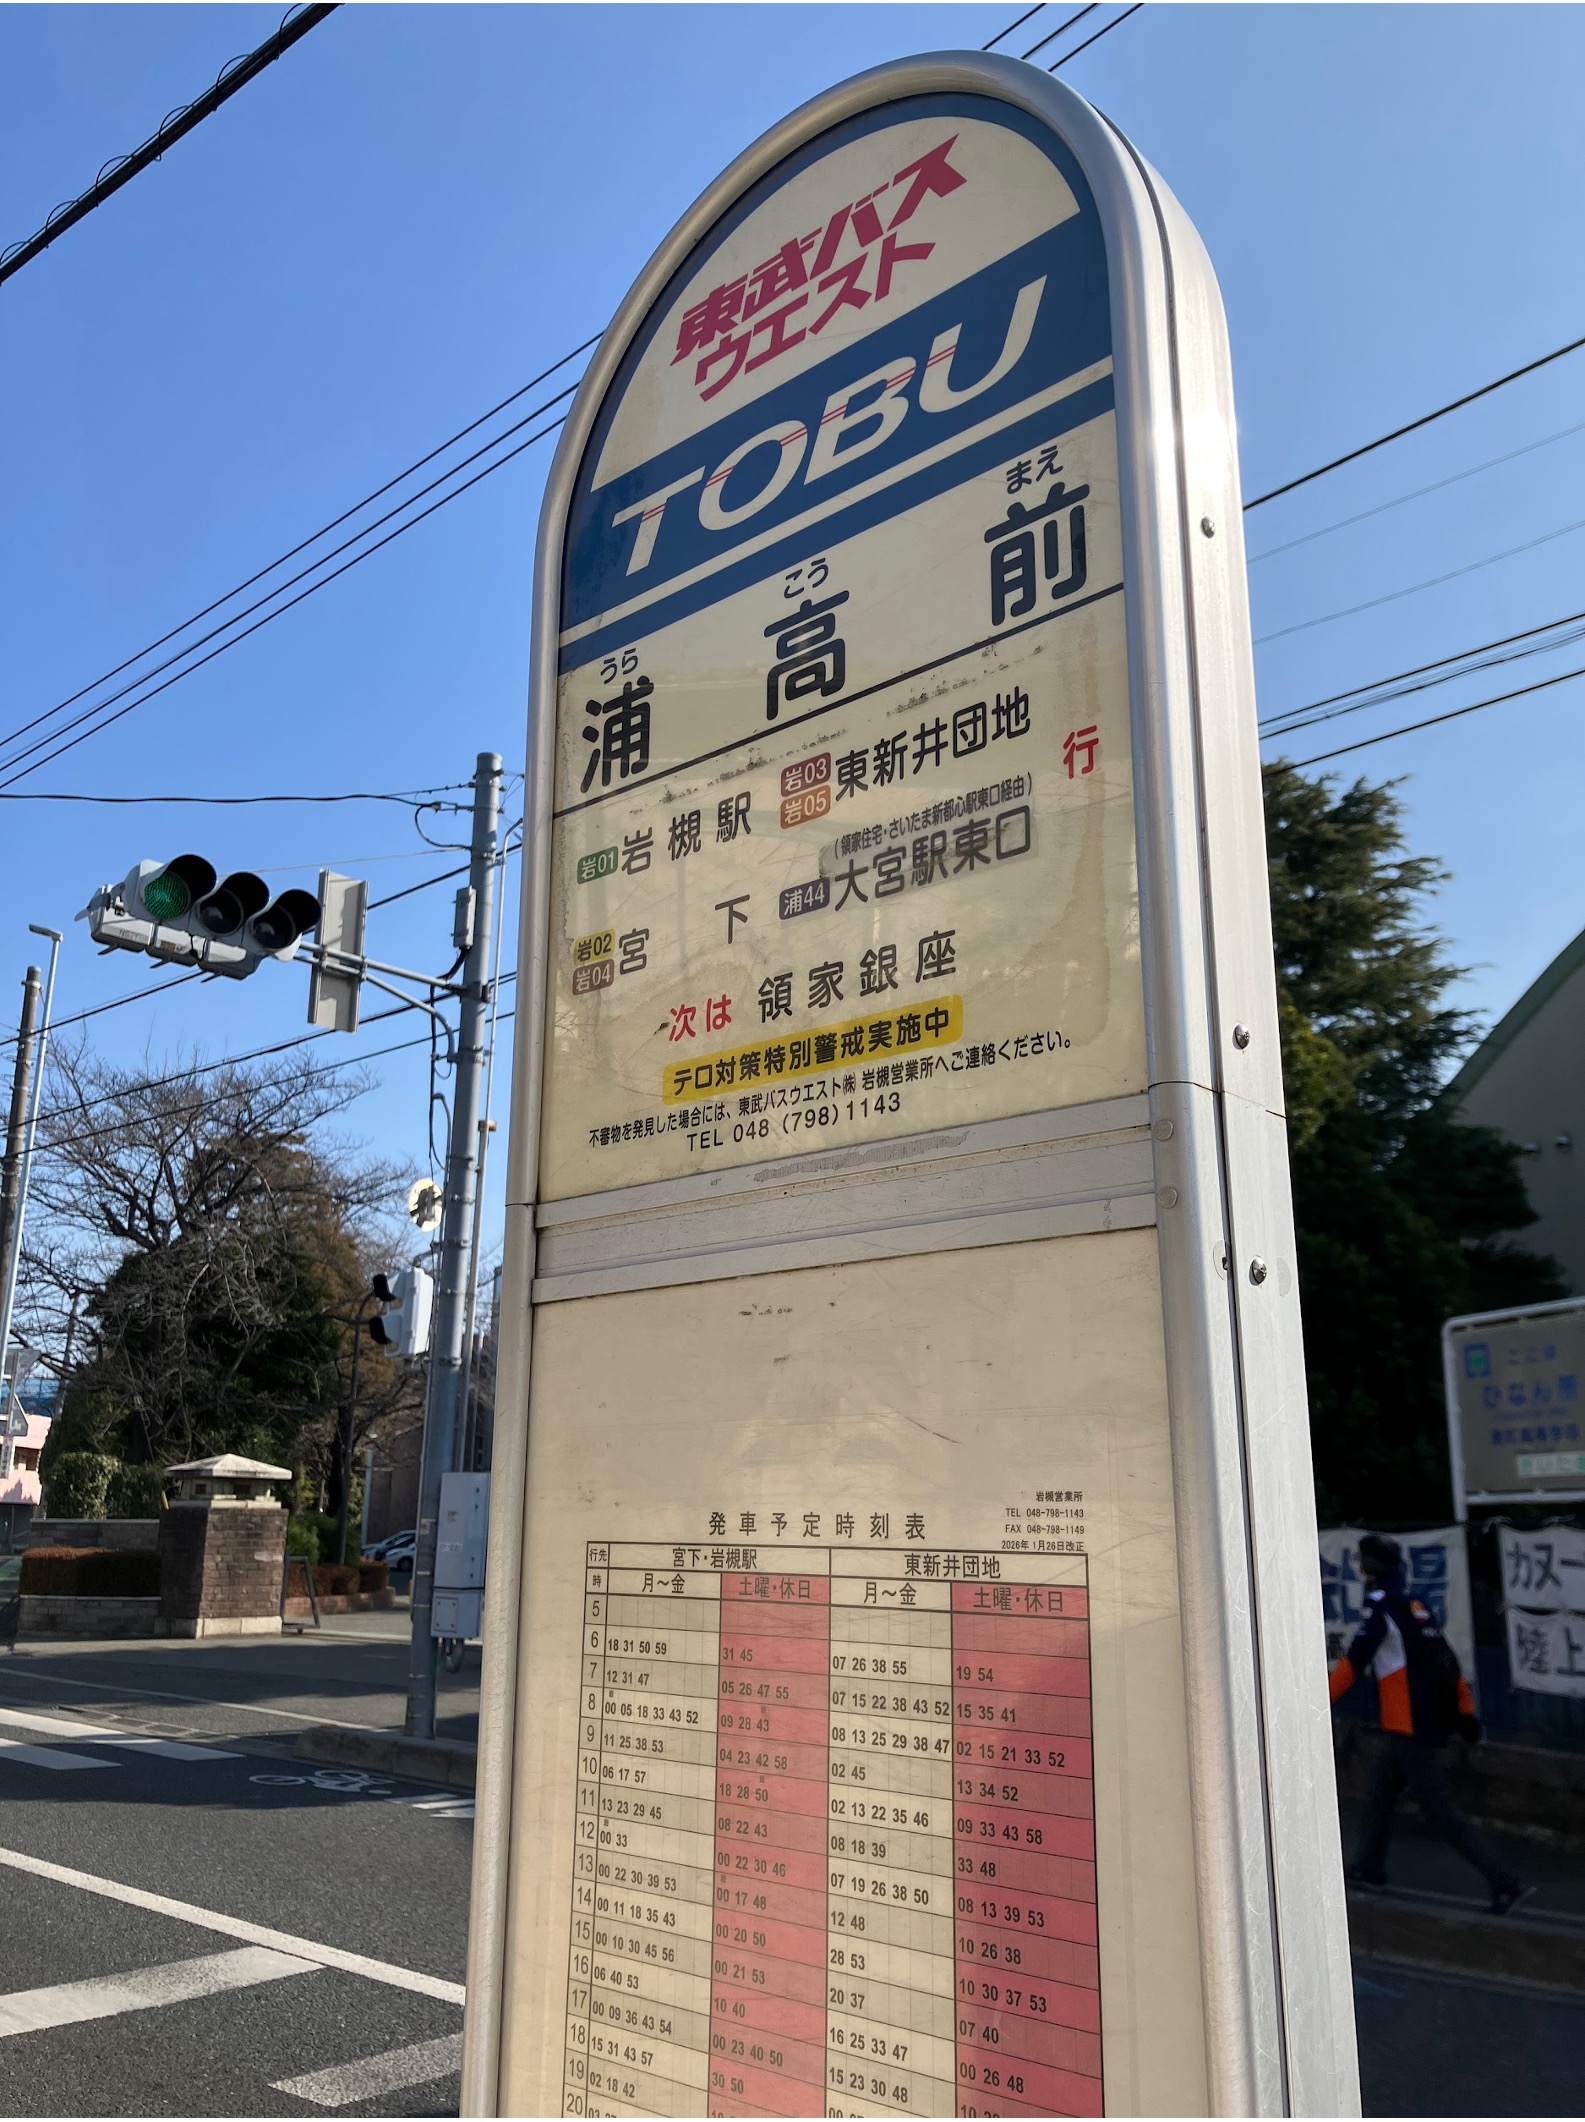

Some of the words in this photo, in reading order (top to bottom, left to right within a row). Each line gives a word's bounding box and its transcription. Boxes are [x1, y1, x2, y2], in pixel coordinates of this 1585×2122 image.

[670, 132, 967, 366] 東武バス
[694, 231, 936, 402] ウエスト
[611, 274, 1048, 576] TOBU
[600, 648, 639, 685] うら
[783, 557, 829, 598] こう
[1006, 445, 1063, 495] まえ
[784, 757, 828, 790] 岩03
[835, 686, 1031, 801] 東新井団地
[1062, 724, 1099, 780] 行
[784, 790, 828, 824] 岩05
[581, 853, 616, 881] 岩01
[621, 790, 751, 875] 岩槻駅
[784, 881, 826, 915] 浦44
[835, 805, 1030, 911] 大宮駅東口
[577, 932, 612, 963] 岩02
[575, 962, 611, 993] 岩04
[668, 993, 732, 1042] 次は
[757, 929, 957, 1023] 領家銀座
[673, 1006, 949, 1096] テロ対策特別警戒実施中
[687, 1130, 724, 1152] TEL
[733, 1118, 769, 1143] 048
[1035, 1491, 1083, 1503] 岩槻営業所
[1005, 1507, 1021, 1518] TEL
[1026, 1508, 1084, 1518] 048-798-1143
[709, 1511, 925, 1540] 発車予定時刻表
[1005, 1524, 1022, 1534] FAX
[1026, 1524, 1085, 1535] 048-798-1149
[589, 1548, 607, 1562] 行先
[672, 1547, 757, 1569] 宮下・岩槻駅
[904, 1553, 1001, 1579] 東新井団地
[592, 1574, 602, 1588] 時
[739, 1576, 811, 1599] 土曜・休日
[592, 1600, 599, 1616] 5
[973, 1586, 1063, 1613] 土曜・休日
[591, 1631, 598, 1648] 6
[608, 1639, 618, 1651] 18
[624, 1640, 633, 1652] 31
[639, 1641, 650, 1654] 50
[655, 1642, 666, 1655] 59
[723, 1648, 733, 1660] 31
[740, 1649, 752, 1661] 45
[590, 1662, 597, 1678] 7
[833, 1656, 846, 1670] 07
[852, 1658, 866, 1671] 26
[872, 1659, 886, 1673] 38
[893, 1661, 906, 1675] 55
[957, 1666, 970, 1680] 19
[978, 1668, 993, 1682] 54
[588, 1694, 595, 1710] 8
[605, 1702, 616, 1714] 00
[621, 1704, 632, 1716] 05
[637, 1705, 648, 1718] 18
[653, 1707, 664, 1720] 33
[669, 1709, 681, 1722] 43
[686, 1711, 698, 1724] 52
[721, 1715, 732, 1727] 09
[739, 1717, 750, 1730] 28
[757, 1719, 768, 1732] 43
[587, 1725, 594, 1742] 9
[604, 1734, 614, 1746] 11
[620, 1736, 630, 1748] 25
[636, 1738, 647, 1750] 38
[652, 1740, 663, 1753] 53
[832, 1727, 845, 1741] 08
[852, 1730, 865, 1744] 13
[872, 1732, 886, 1746] 25
[893, 1734, 906, 1748] 29
[914, 1736, 928, 1751] 38
[934, 1739, 950, 1753] 47
[583, 1756, 597, 1774] 10
[720, 1749, 732, 1762] 04
[738, 1751, 750, 1764] 23
[756, 1754, 768, 1767] 42
[775, 1756, 786, 1769] 58
[957, 1741, 972, 1756] 02
[980, 1744, 994, 1759] 15
[1002, 1746, 1016, 1762] 21
[1025, 1749, 1040, 1764] 33
[1049, 1752, 1064, 1768] 52
[832, 1763, 845, 1778] 02
[852, 1766, 865, 1780] 45
[582, 1788, 594, 1806] 11
[958, 1780, 972, 1795] 13
[980, 1783, 995, 1798] 34
[1002, 1786, 1018, 1802] 52
[602, 1798, 612, 1811] 13
[617, 1801, 628, 1814] 23
[633, 1803, 644, 1816] 29
[650, 1806, 661, 1819] 45
[581, 1821, 594, 1839] 12
[719, 1818, 730, 1831] 08
[736, 1820, 748, 1834] 22
[754, 1824, 767, 1837] 43
[831, 1836, 844, 1851] 08
[852, 1840, 865, 1854] 18
[872, 1843, 886, 1858] 39
[579, 1854, 593, 1872] 13
[958, 1857, 973, 1873] 33
[980, 1861, 996, 1877] 48
[599, 1864, 610, 1878] 00
[615, 1867, 626, 1881] 22
[631, 1870, 642, 1884] 30
[648, 1874, 659, 1888] 39
[665, 1878, 676, 1891] 53
[578, 1886, 591, 1905] 14
[717, 1888, 729, 1902] 00
[736, 1892, 747, 1905] 17
[754, 1896, 766, 1910] 48
[576, 1920, 590, 1940] 15
[831, 1911, 844, 1927] 12
[851, 1915, 865, 1931] 48
[960, 1938, 974, 1954] 10
[982, 1942, 997, 1960] 26
[1005, 1947, 1021, 1964] 38
[574, 1954, 588, 1974] 16
[594, 1966, 605, 1980] 06
[610, 1970, 622, 1985] 40
[627, 1975, 638, 1989] 53
[573, 1989, 587, 2008] 17
[715, 1998, 726, 2012] 10
[733, 2003, 744, 2017] 40
[593, 2001, 604, 2016] 00
[609, 2006, 620, 2020] 09
[626, 2010, 637, 2025] 36
[642, 2015, 654, 2030] 43
[660, 2019, 671, 2035] 54
[571, 2024, 585, 2044] 18
[830, 2028, 844, 2044] 16
[850, 2033, 864, 2050] 25
[872, 2038, 886, 2056] 33
[893, 2044, 908, 2061] 47
[570, 2058, 584, 2079] 19
[960, 2062, 976, 2080] 00
[984, 2068, 1000, 2086] 26
[1007, 2075, 1024, 2094] 48
[567, 2093, 582, 2115] 20
